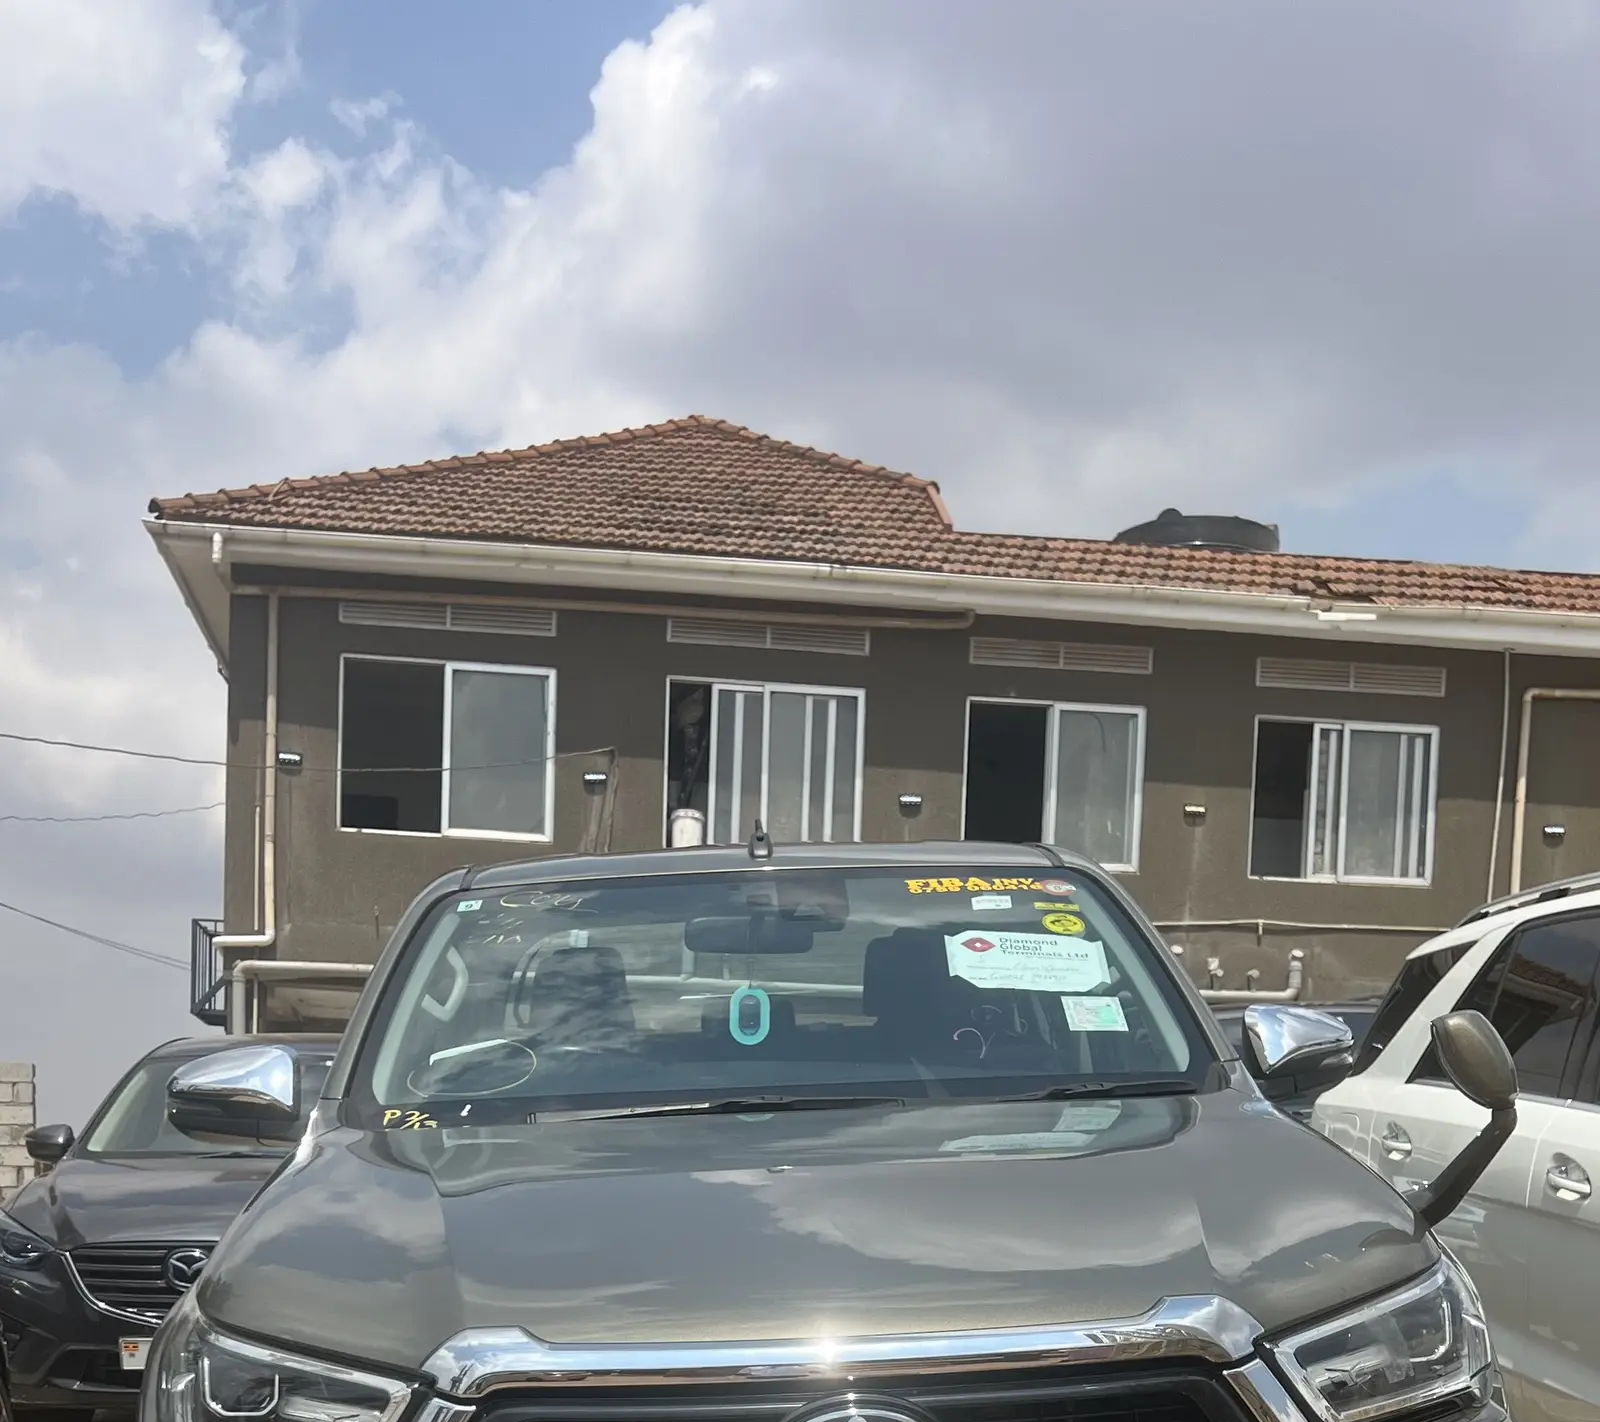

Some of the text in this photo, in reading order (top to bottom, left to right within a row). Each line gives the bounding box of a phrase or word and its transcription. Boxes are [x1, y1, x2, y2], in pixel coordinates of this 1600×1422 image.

[999, 937, 1059, 946] Diamond
[1000, 943, 1042, 952] Global
[1002, 949, 1062, 958] Terminals
